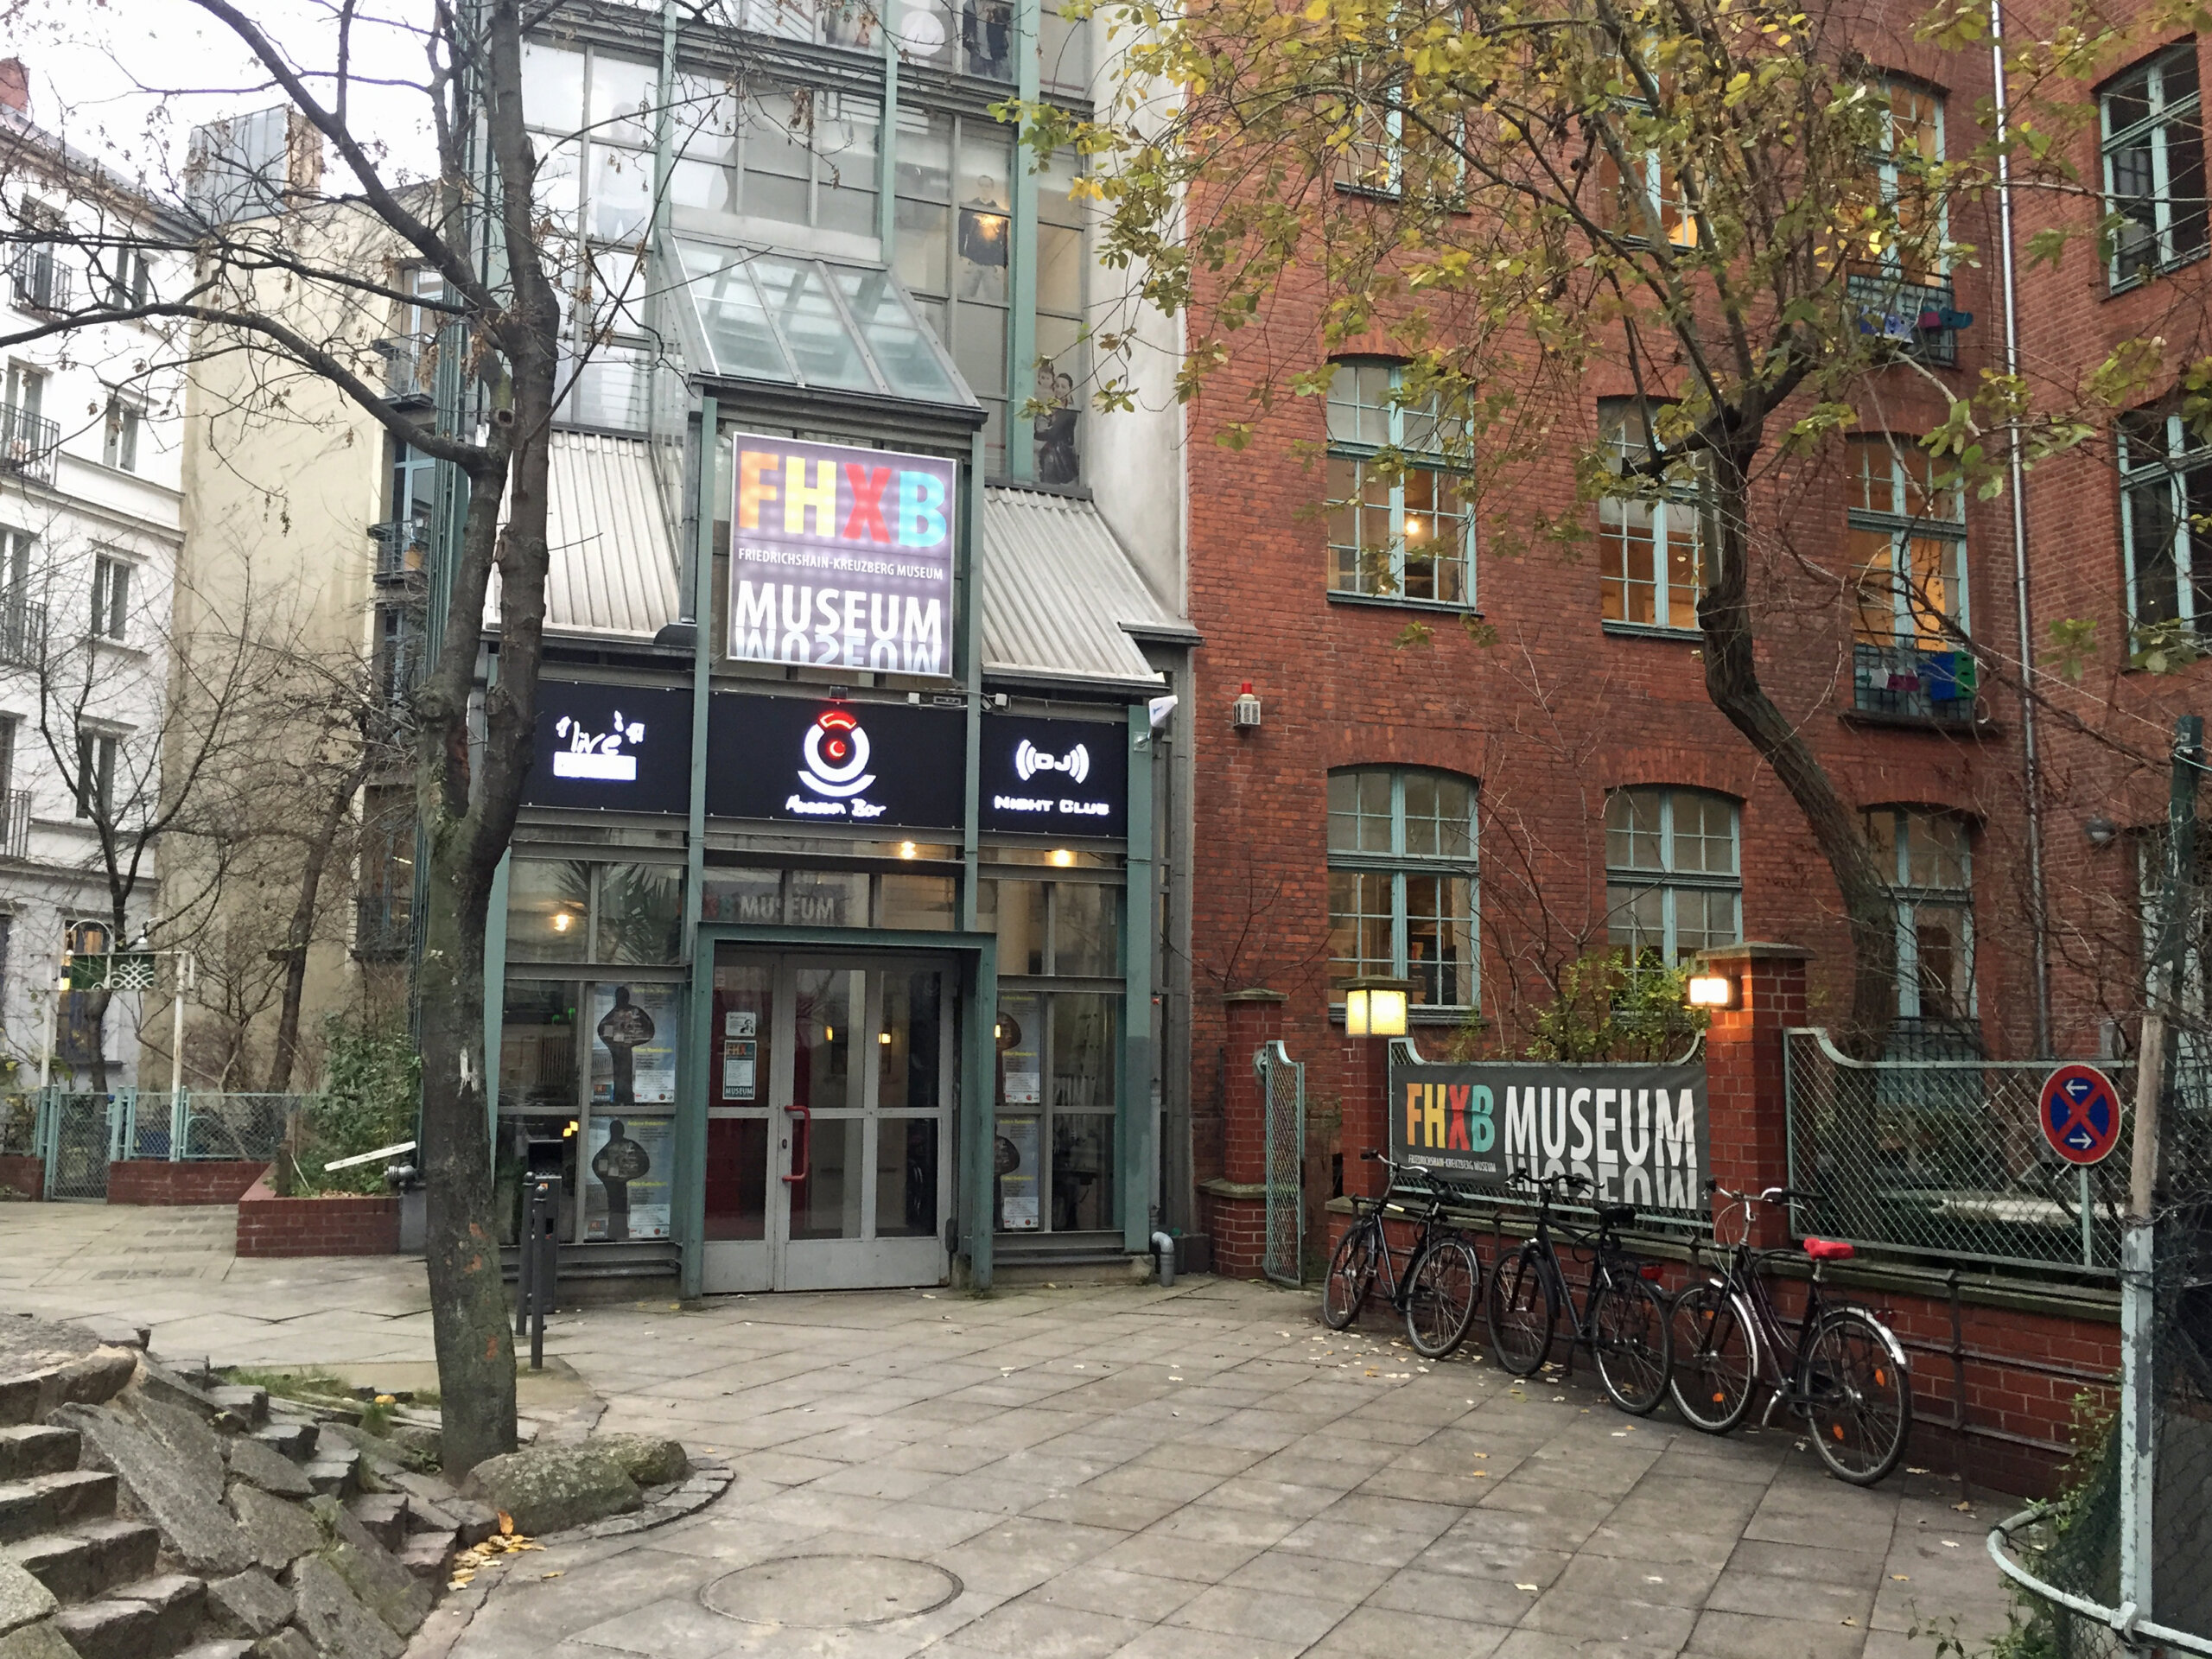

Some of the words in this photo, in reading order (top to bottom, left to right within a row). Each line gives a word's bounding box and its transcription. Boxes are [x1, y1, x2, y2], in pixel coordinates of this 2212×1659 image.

[739, 450, 947, 548] FHXB
[738, 548, 895, 575] FRIEDRICHSHAIN-KREUZBERG
[896, 565, 944, 580] MUSEUM
[735, 580, 943, 644] MUSEUM
[1034, 753, 1071, 771] DJ
[1406, 1083, 1496, 1154] FHXB
[1504, 1086, 1698, 1170] MUSEUM
[1473, 1160, 1497, 1173] MUSEUM
